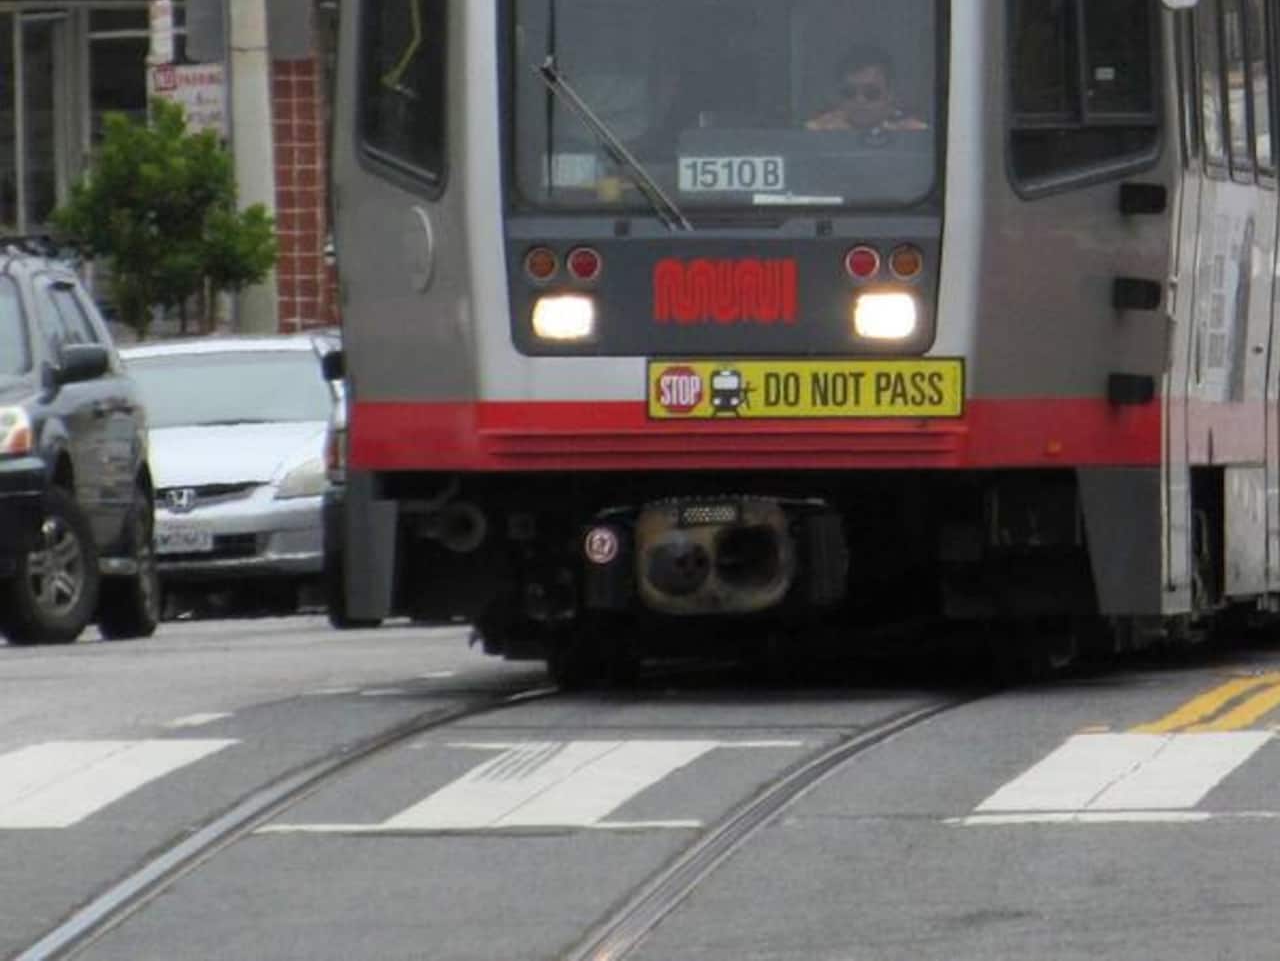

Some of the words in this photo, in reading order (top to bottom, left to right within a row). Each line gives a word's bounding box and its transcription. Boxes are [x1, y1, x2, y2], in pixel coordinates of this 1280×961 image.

[659, 374, 700, 405] STOP
[763, 372, 800, 407] DO
[810, 371, 864, 406] NOT
[875, 371, 944, 406] PASS
